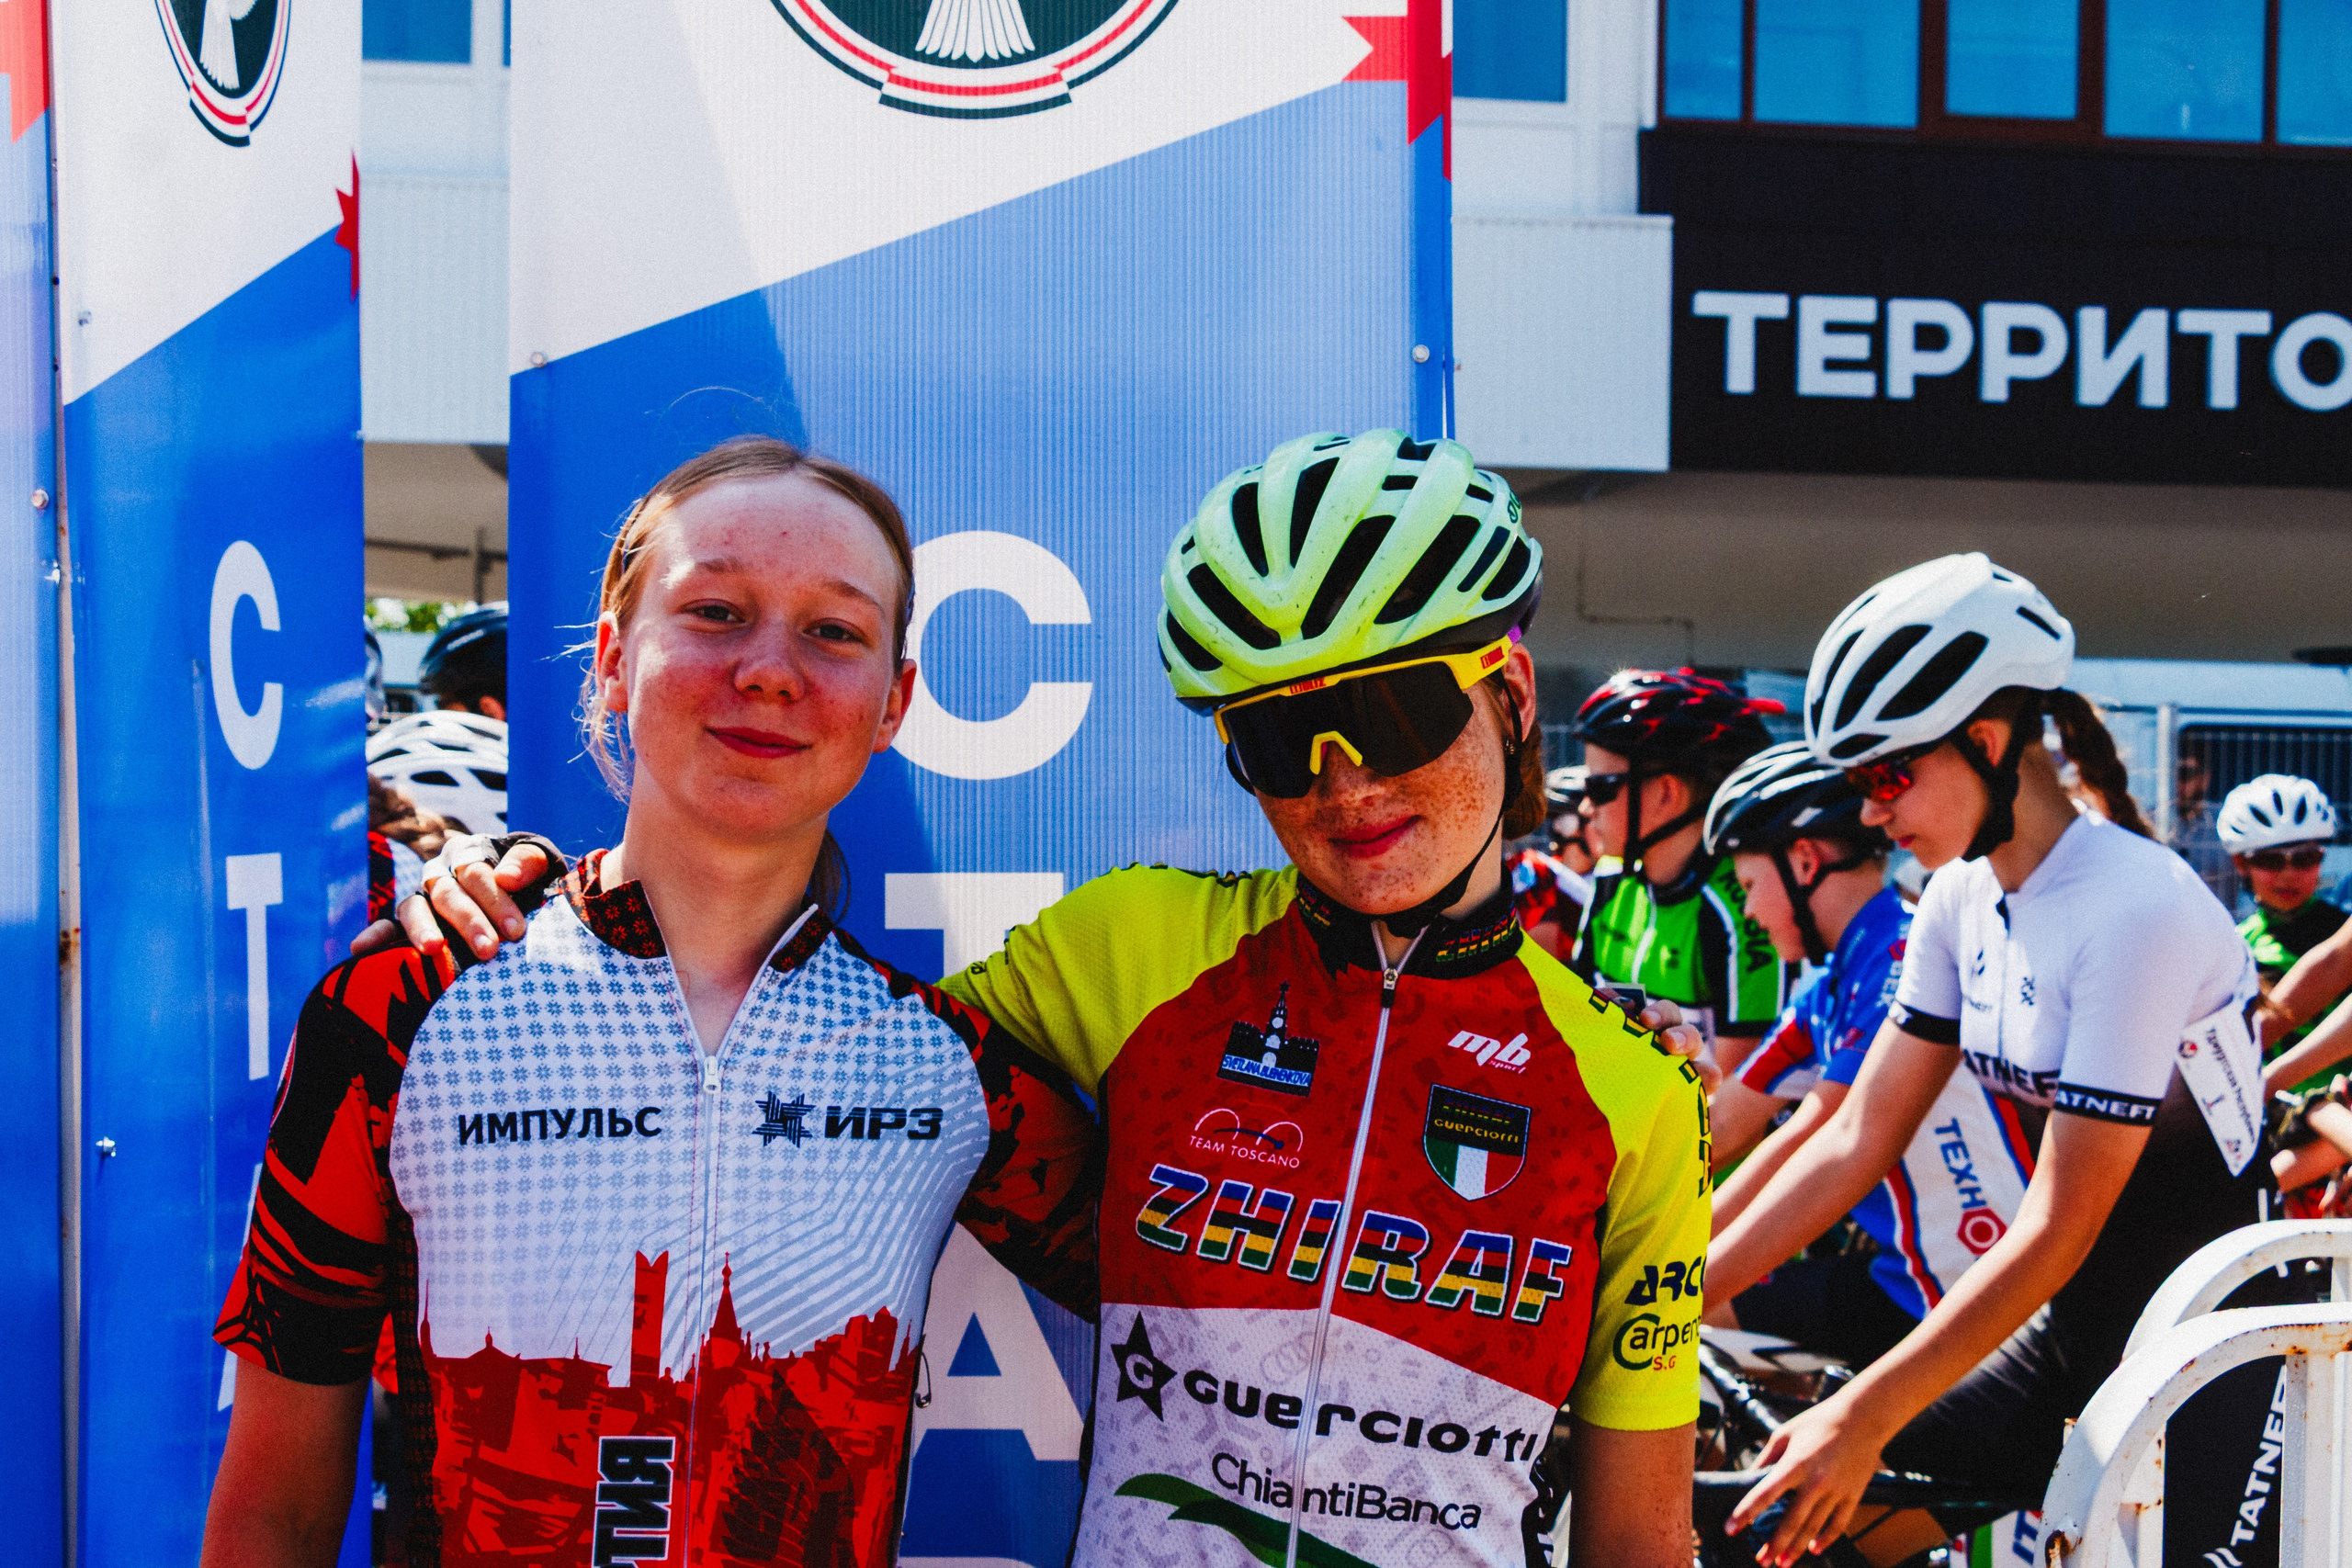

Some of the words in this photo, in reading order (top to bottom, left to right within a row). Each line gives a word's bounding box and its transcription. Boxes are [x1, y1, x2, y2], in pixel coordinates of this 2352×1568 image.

[1691, 288, 2352, 412] ТЕРРИТО
[458, 1106, 662, 1145] ИМПУЛЬС
[824, 1105, 944, 1141] ИРЗ
[1190, 1134, 1225, 1153] TEAM
[1231, 1145, 1300, 1168] TOSCANO
[1136, 1163, 1573, 1325] ZHIRAF
[1612, 1313, 1702, 1371] Carpen
[592, 1436, 676, 1568] ТИЯ
[1212, 1452, 1482, 1530] ChiantiBanca
